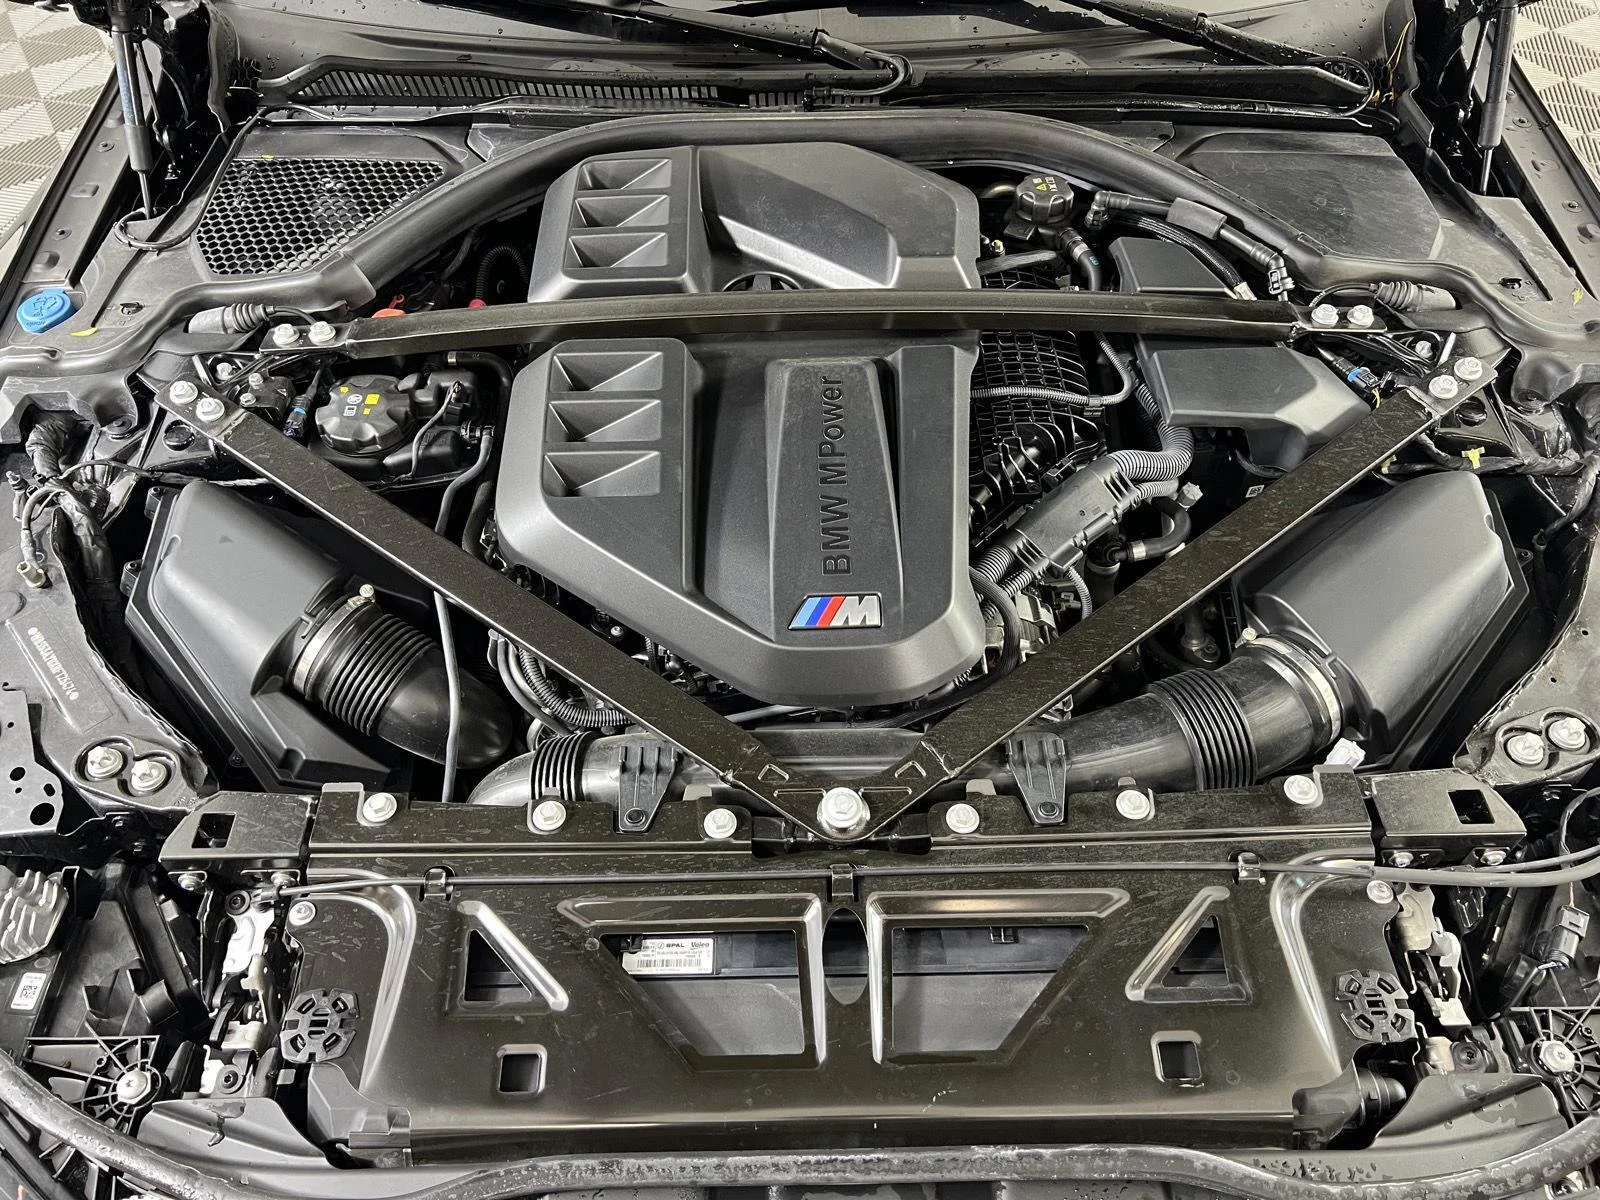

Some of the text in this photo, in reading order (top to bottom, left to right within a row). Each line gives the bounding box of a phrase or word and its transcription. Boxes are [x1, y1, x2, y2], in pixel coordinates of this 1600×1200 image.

[818, 376, 852, 576] BMW MPower
[691, 941, 710, 949] Valeo
